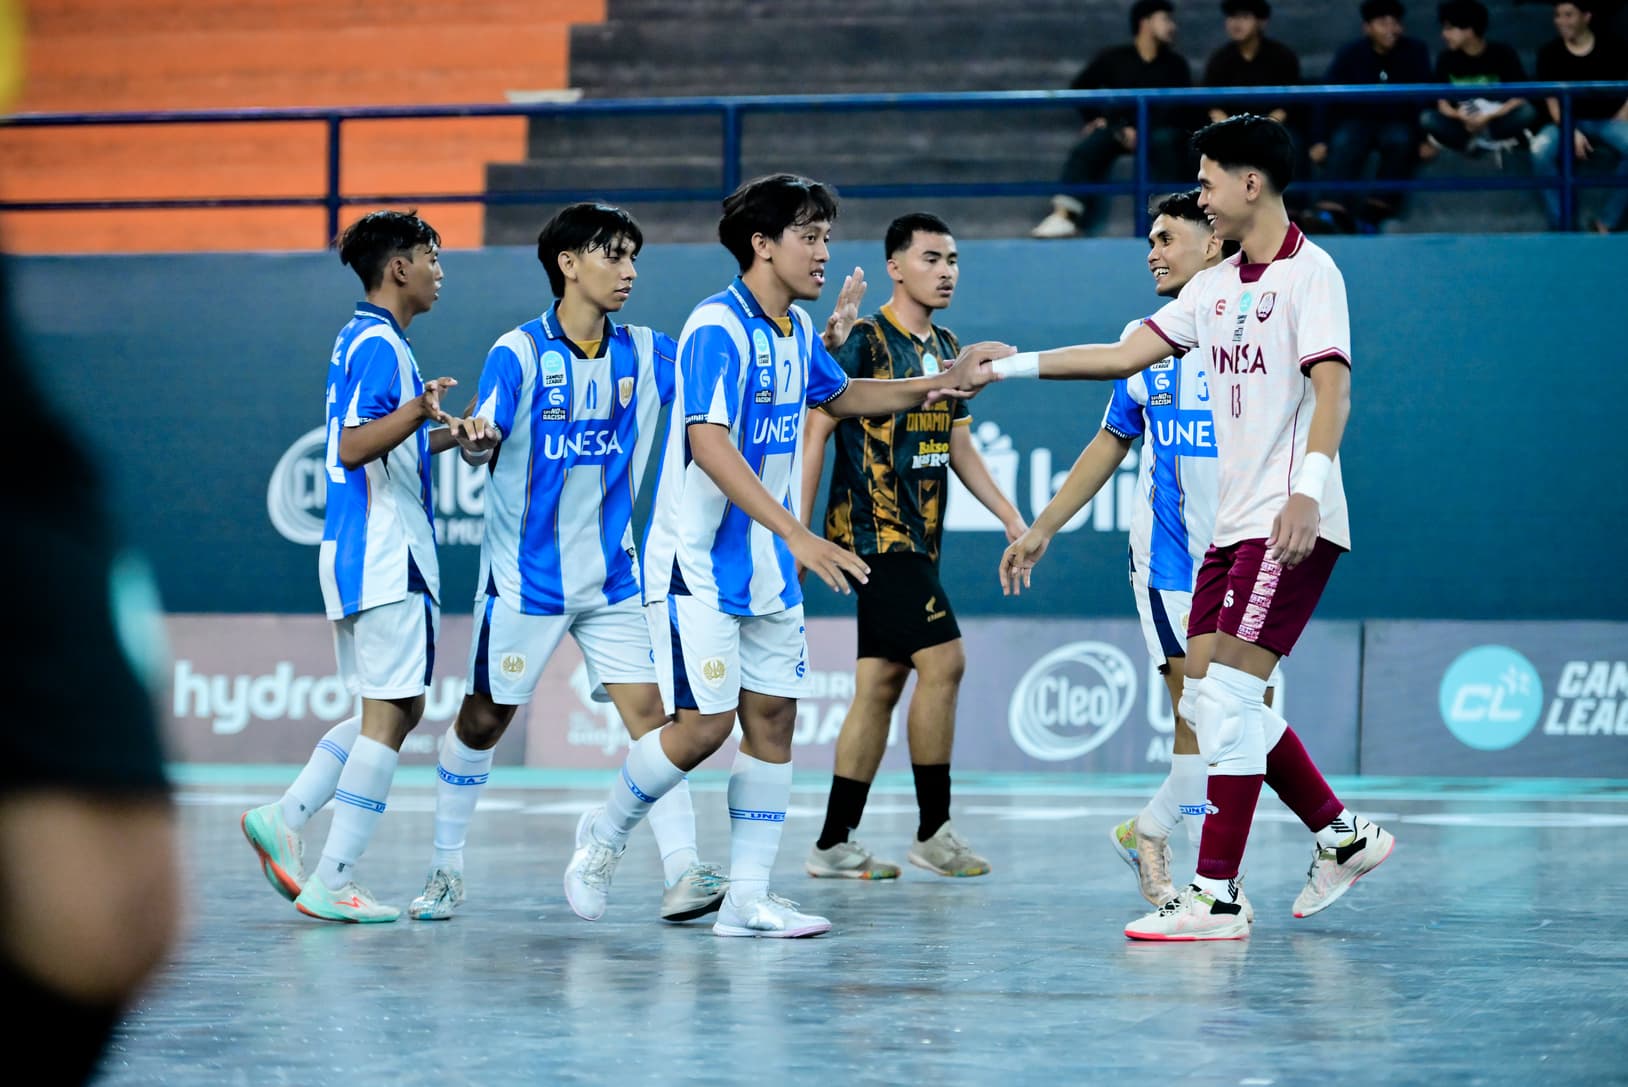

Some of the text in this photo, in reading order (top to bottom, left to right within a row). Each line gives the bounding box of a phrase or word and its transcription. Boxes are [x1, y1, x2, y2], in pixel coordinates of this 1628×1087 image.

[784, 359, 792, 393] 7
[1197, 370, 1210, 402] 3
[1231, 383, 1242, 419] 13
[544, 430, 624, 460] UNESA
[1157, 419, 1217, 447] UNE
[1036, 676, 1110, 726] Cleo
